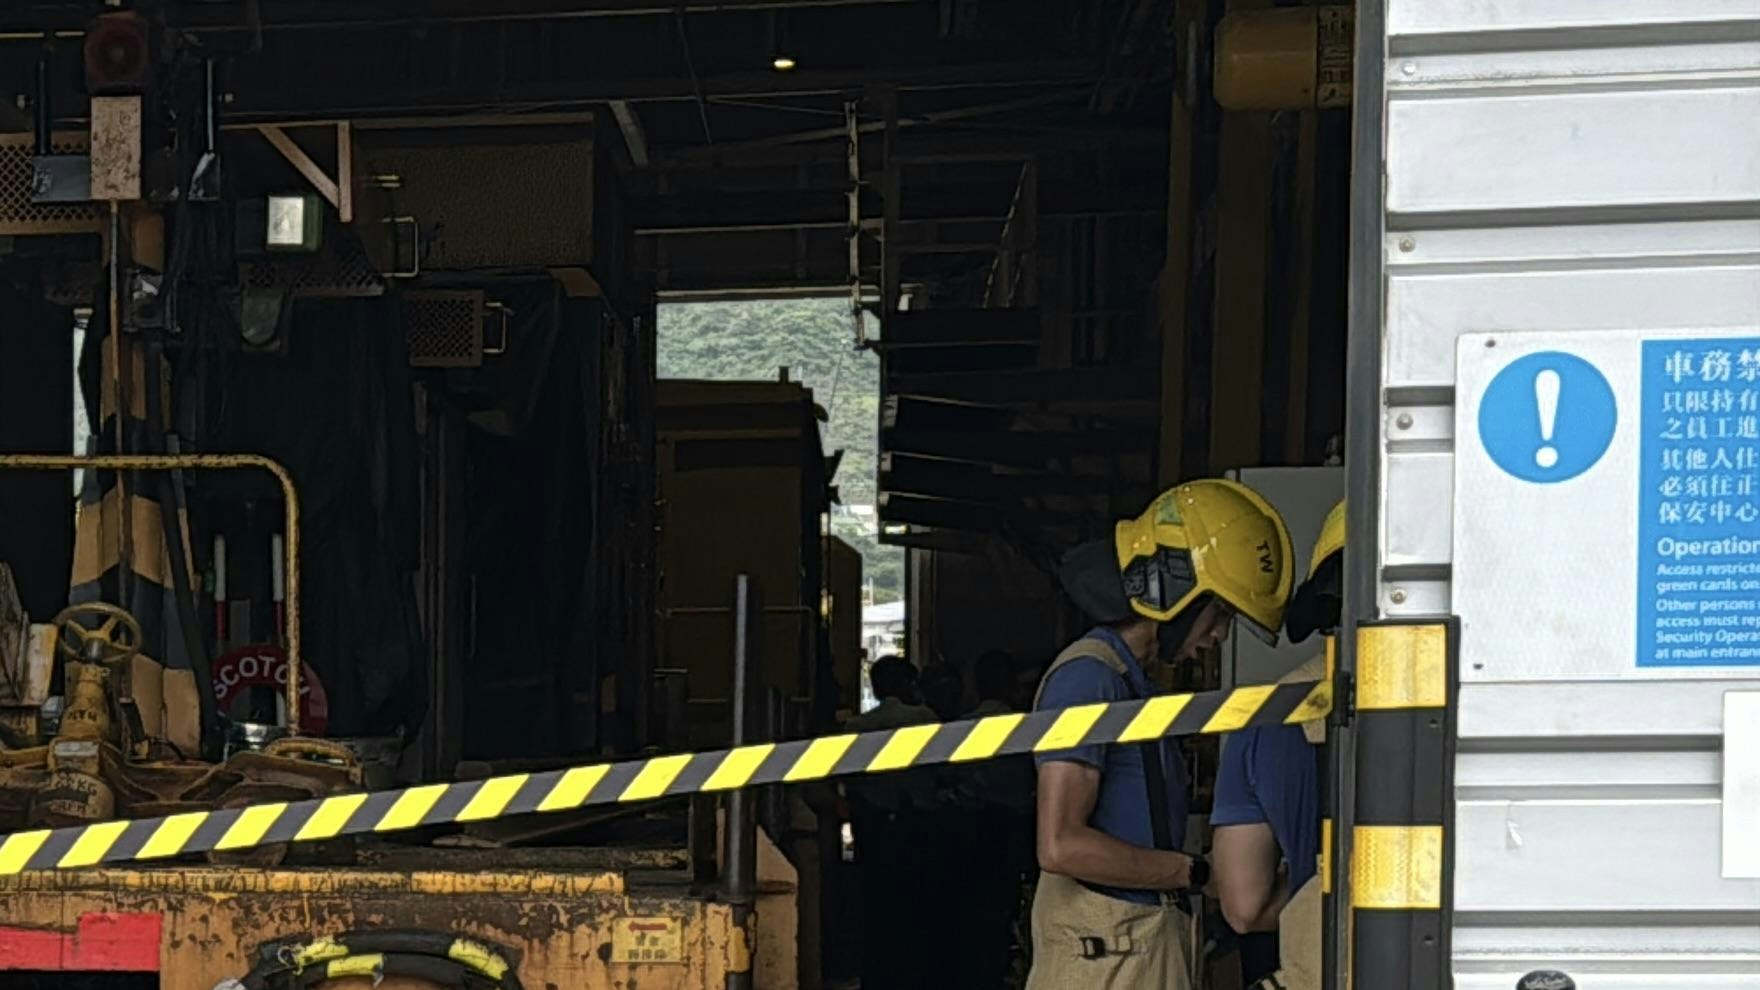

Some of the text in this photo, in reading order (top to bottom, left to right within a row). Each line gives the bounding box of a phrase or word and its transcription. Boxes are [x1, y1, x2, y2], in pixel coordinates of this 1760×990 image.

[1658, 500, 1760, 524] 保安中心
[1656, 563, 1704, 576] Access
[1656, 581, 1698, 596] green
[1700, 577, 1738, 592] cards
[1656, 598, 1756, 615] Other persons
[1656, 617, 1701, 628] access
[1703, 615, 1739, 627] must
[1655, 630, 1713, 646] Security
[1655, 648, 1670, 660] at
[1671, 646, 1709, 659] main
